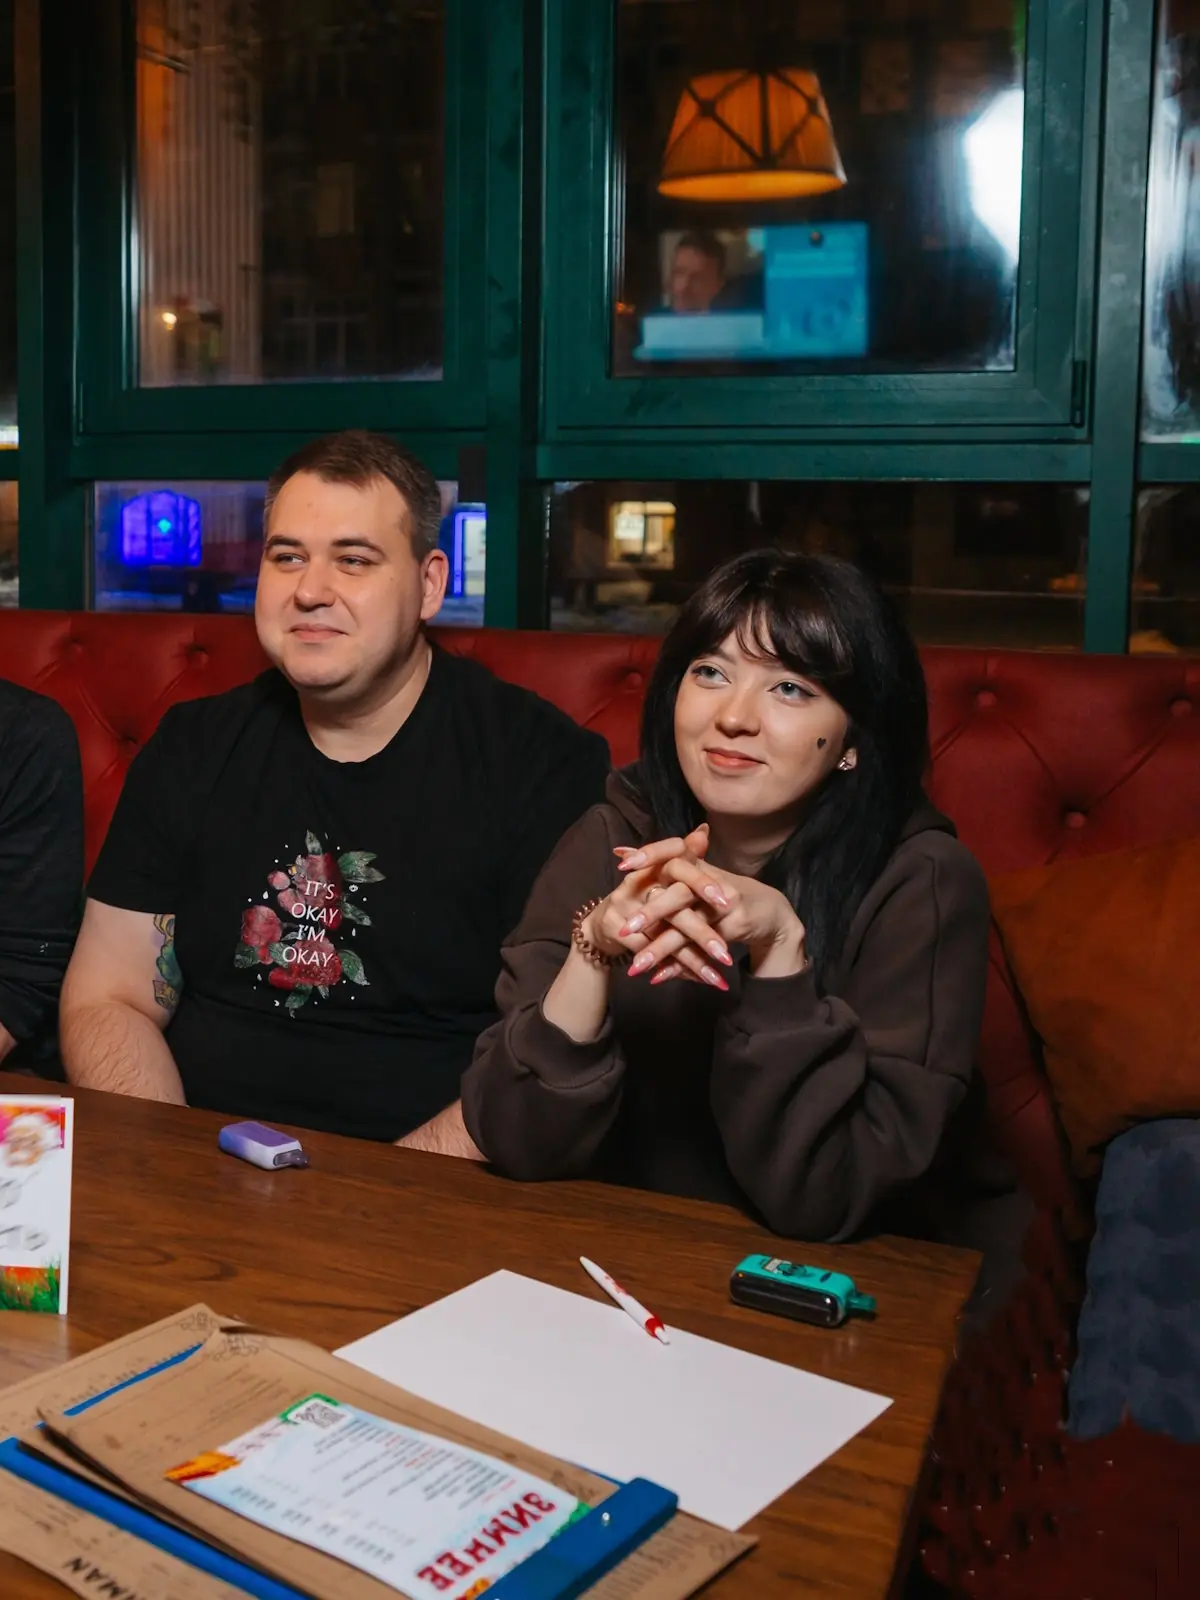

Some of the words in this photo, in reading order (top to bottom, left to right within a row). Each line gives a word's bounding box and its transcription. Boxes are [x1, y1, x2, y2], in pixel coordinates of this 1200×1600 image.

[304, 881, 336, 901] IT'S
[291, 902, 339, 925] OKAY
[296, 924, 325, 943] I'M
[282, 946, 334, 968] OKAY
[416, 1491, 558, 1591] ЗИМНЕЕ
